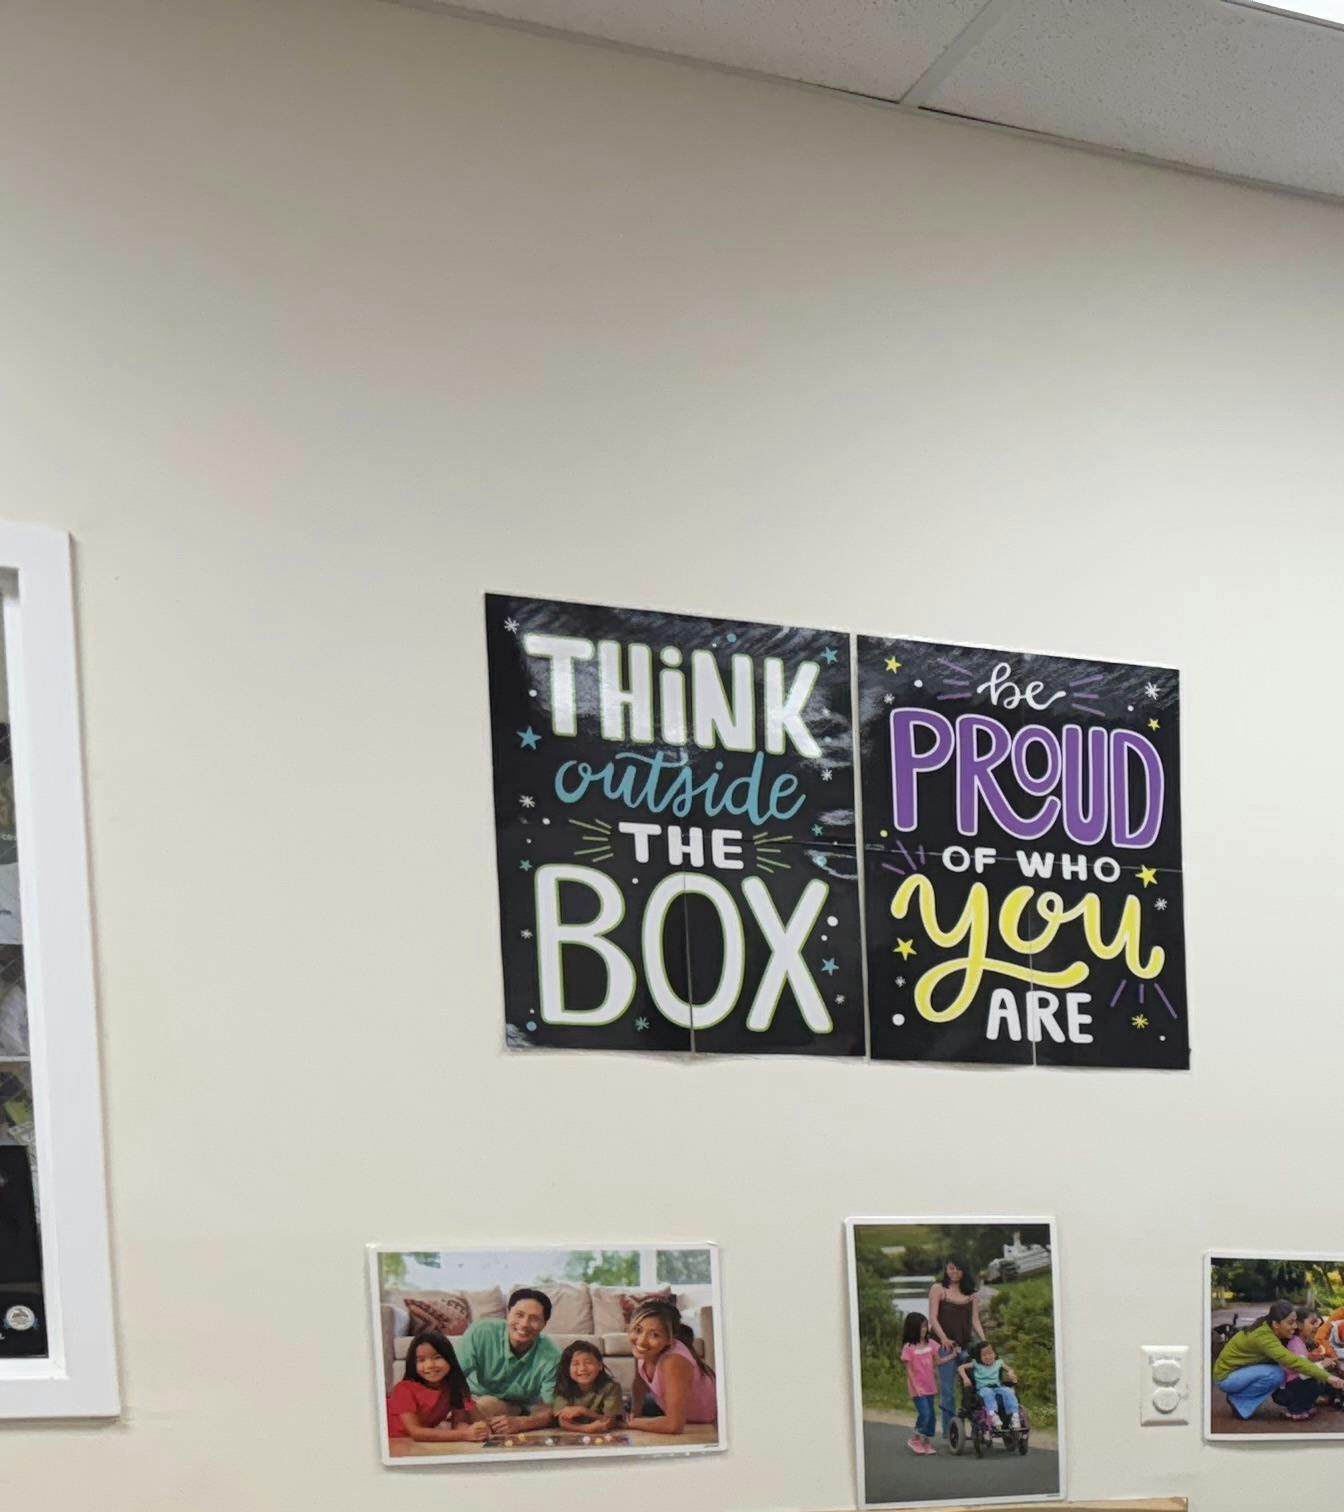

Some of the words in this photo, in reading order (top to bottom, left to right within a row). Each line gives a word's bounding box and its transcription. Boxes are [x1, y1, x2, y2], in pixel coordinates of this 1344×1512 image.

[976, 661, 1068, 710] be
[555, 751, 806, 826] outside
[890, 707, 1165, 848] PROUD
[618, 821, 745, 870] THE
[942, 845, 997, 875] OF
[1018, 849, 1121, 883] WHO
[534, 863, 834, 1034] BOX
[890, 874, 1166, 1023] you
[986, 988, 1094, 1044] ARE
